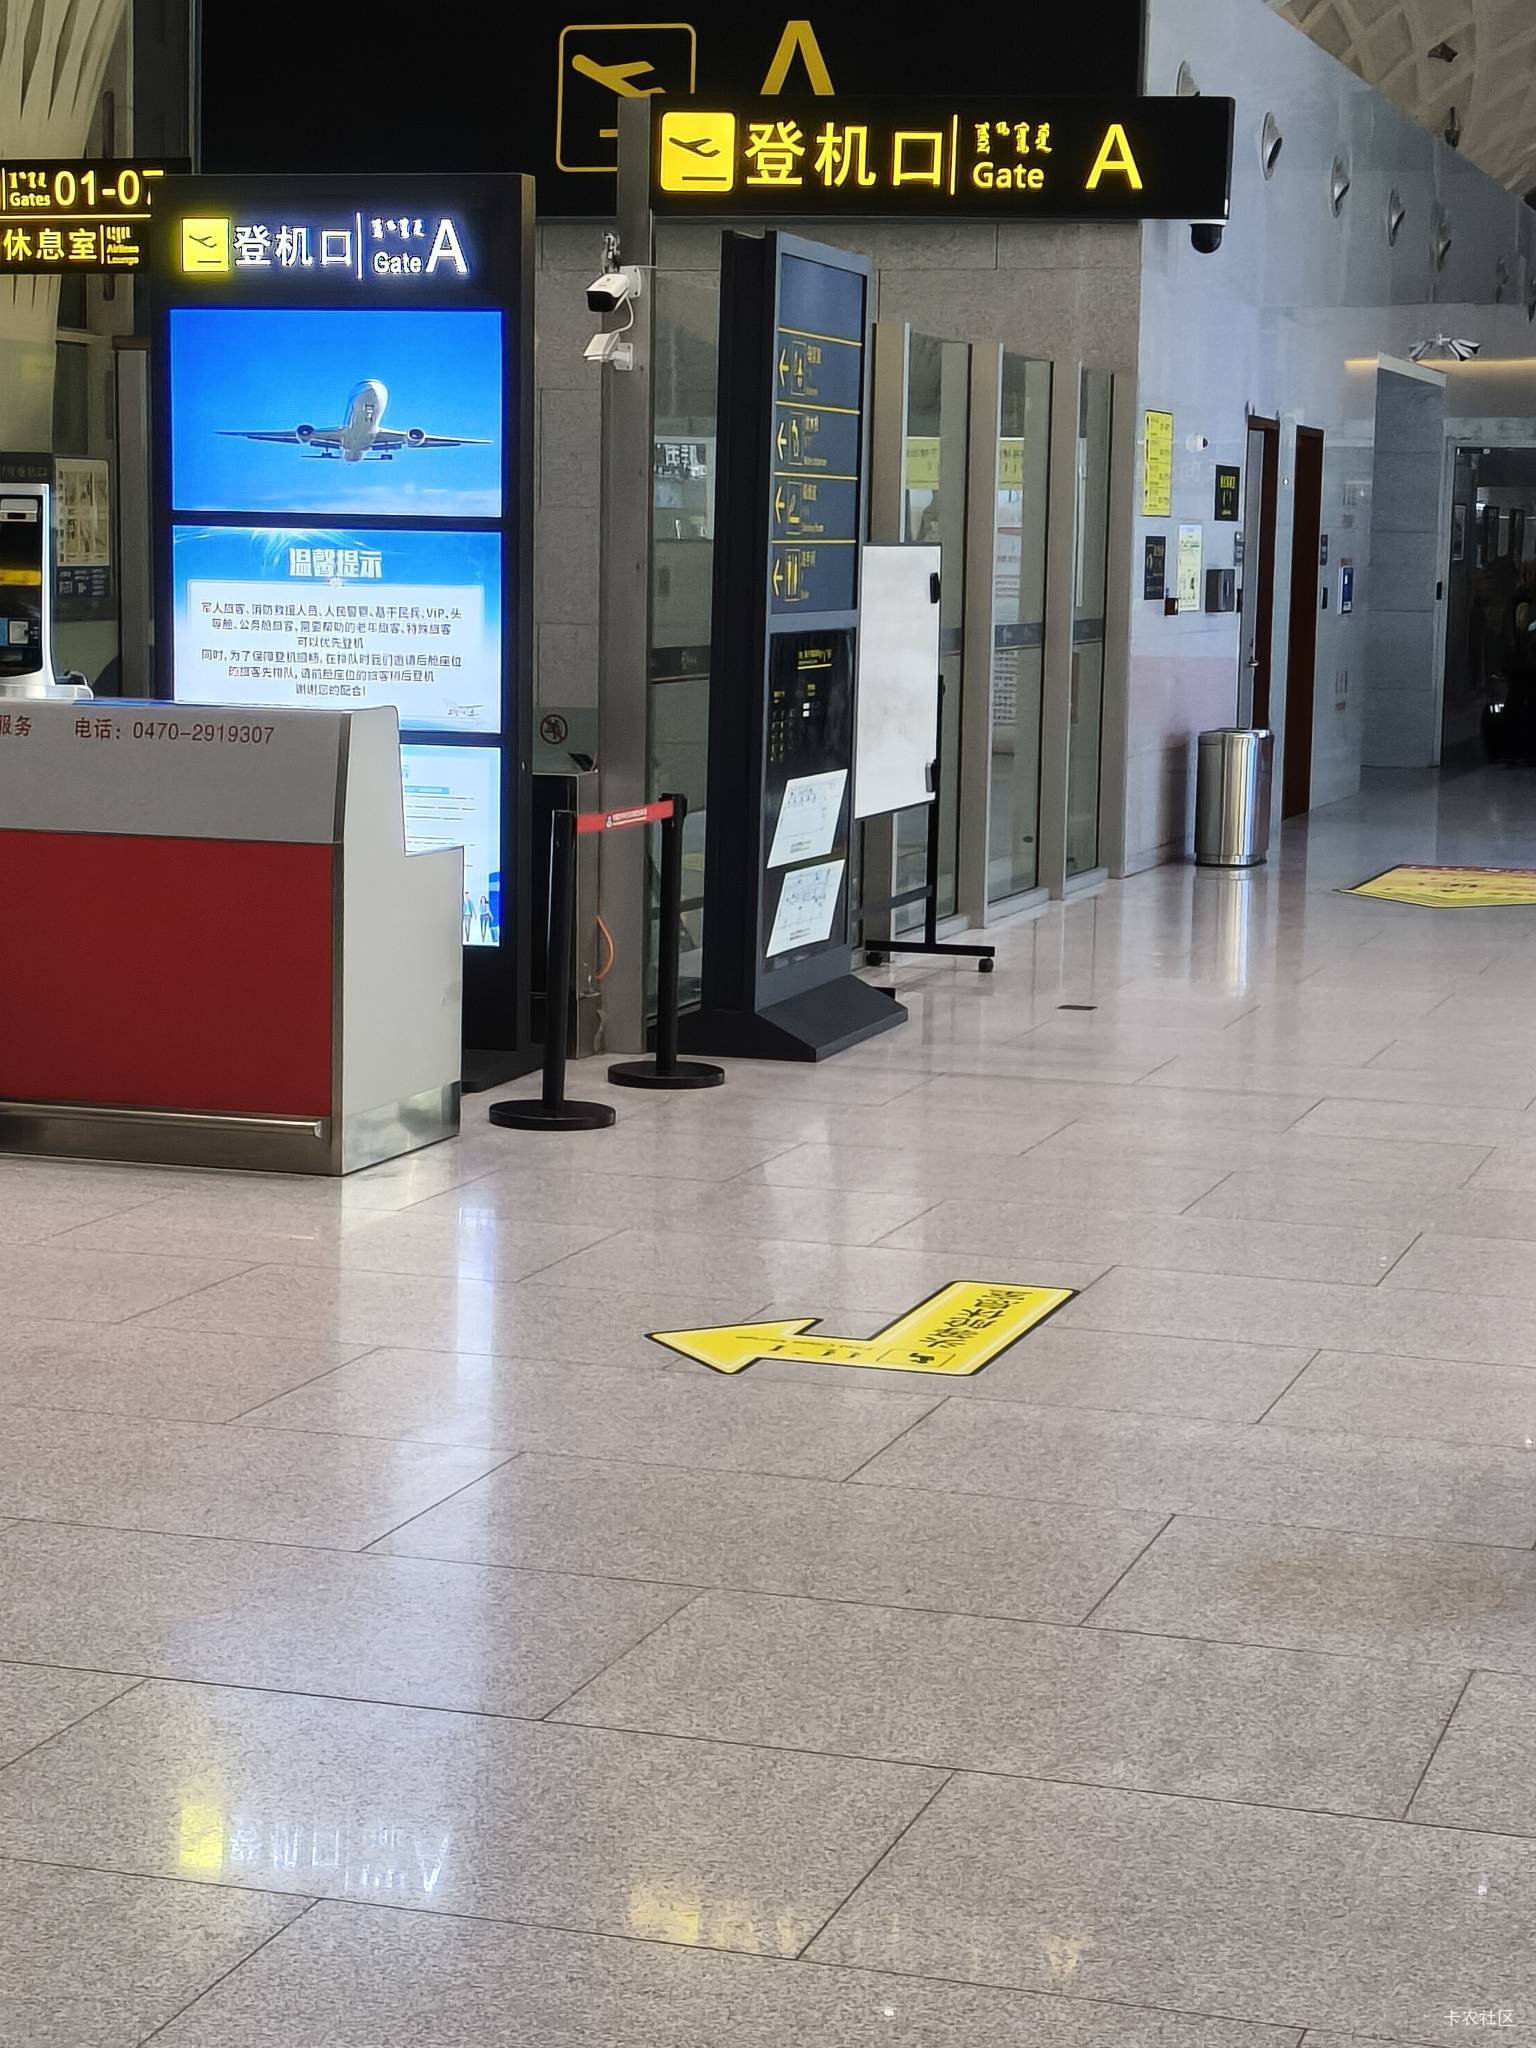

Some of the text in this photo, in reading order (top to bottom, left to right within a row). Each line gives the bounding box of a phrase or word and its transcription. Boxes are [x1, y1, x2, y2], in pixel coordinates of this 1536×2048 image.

[743, 119, 944, 188] 登机口
[972, 161, 1045, 189] Gate
[1085, 123, 1144, 191] A
[8, 191, 51, 207] Gates
[3, 227, 98, 262] 休息室
[232, 223, 352, 268] 登机口
[372, 250, 423, 274] Gate
[425, 218, 469, 274] A
[288, 547, 383, 579] 温馨提示
